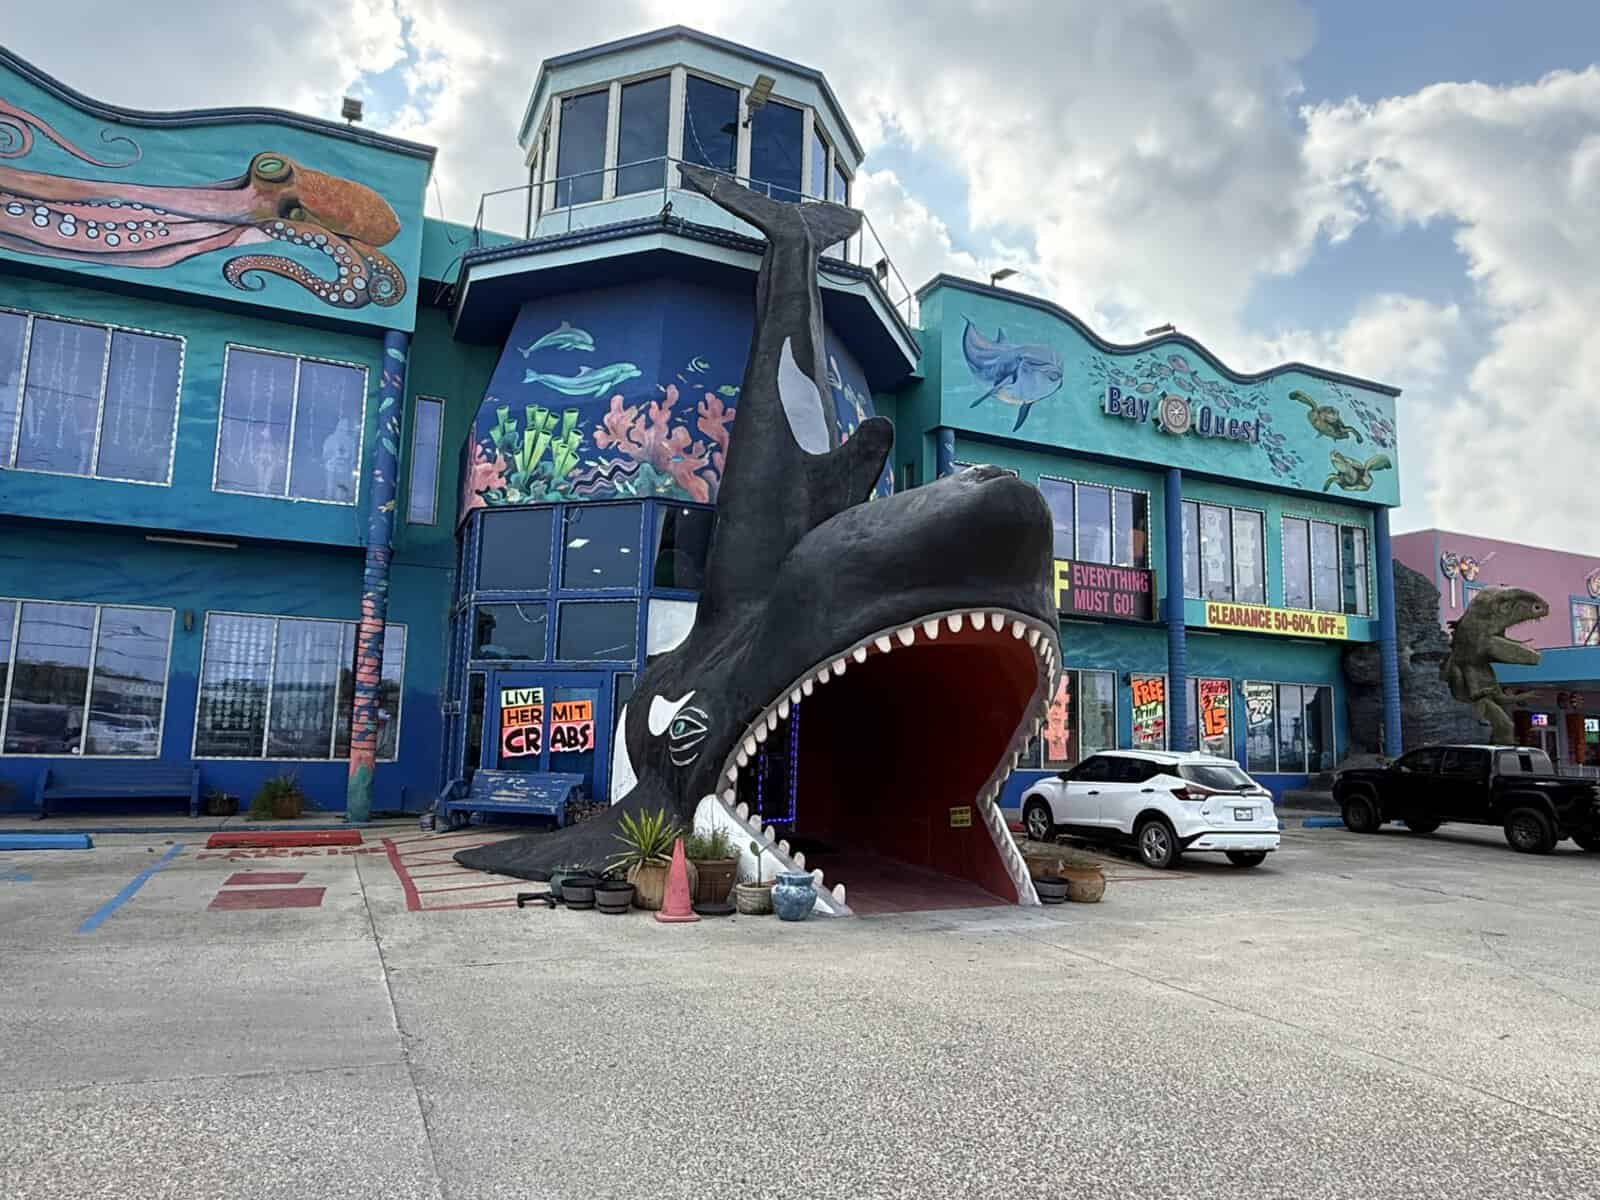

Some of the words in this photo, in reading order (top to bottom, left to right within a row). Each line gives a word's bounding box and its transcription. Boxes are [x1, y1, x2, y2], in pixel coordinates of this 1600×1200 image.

[1105, 387, 1149, 423] Bay
[1196, 406, 1263, 444] Quest
[1072, 564, 1149, 593] EVERYTHING
[1074, 588, 1110, 613] MUST
[1113, 592, 1135, 616] GO!
[1208, 604, 1273, 629] CLEARANCE
[1274, 611, 1316, 633] 50-60%
[1318, 615, 1337, 635] OFF
[505, 690, 541, 705] LIVE
[1131, 680, 1165, 708] FREE
[506, 708, 543, 724] HER
[552, 704, 587, 721] MIT
[1204, 708, 1227, 736] 15
[505, 726, 541, 753] CR
[550, 724, 591, 749] ABS
